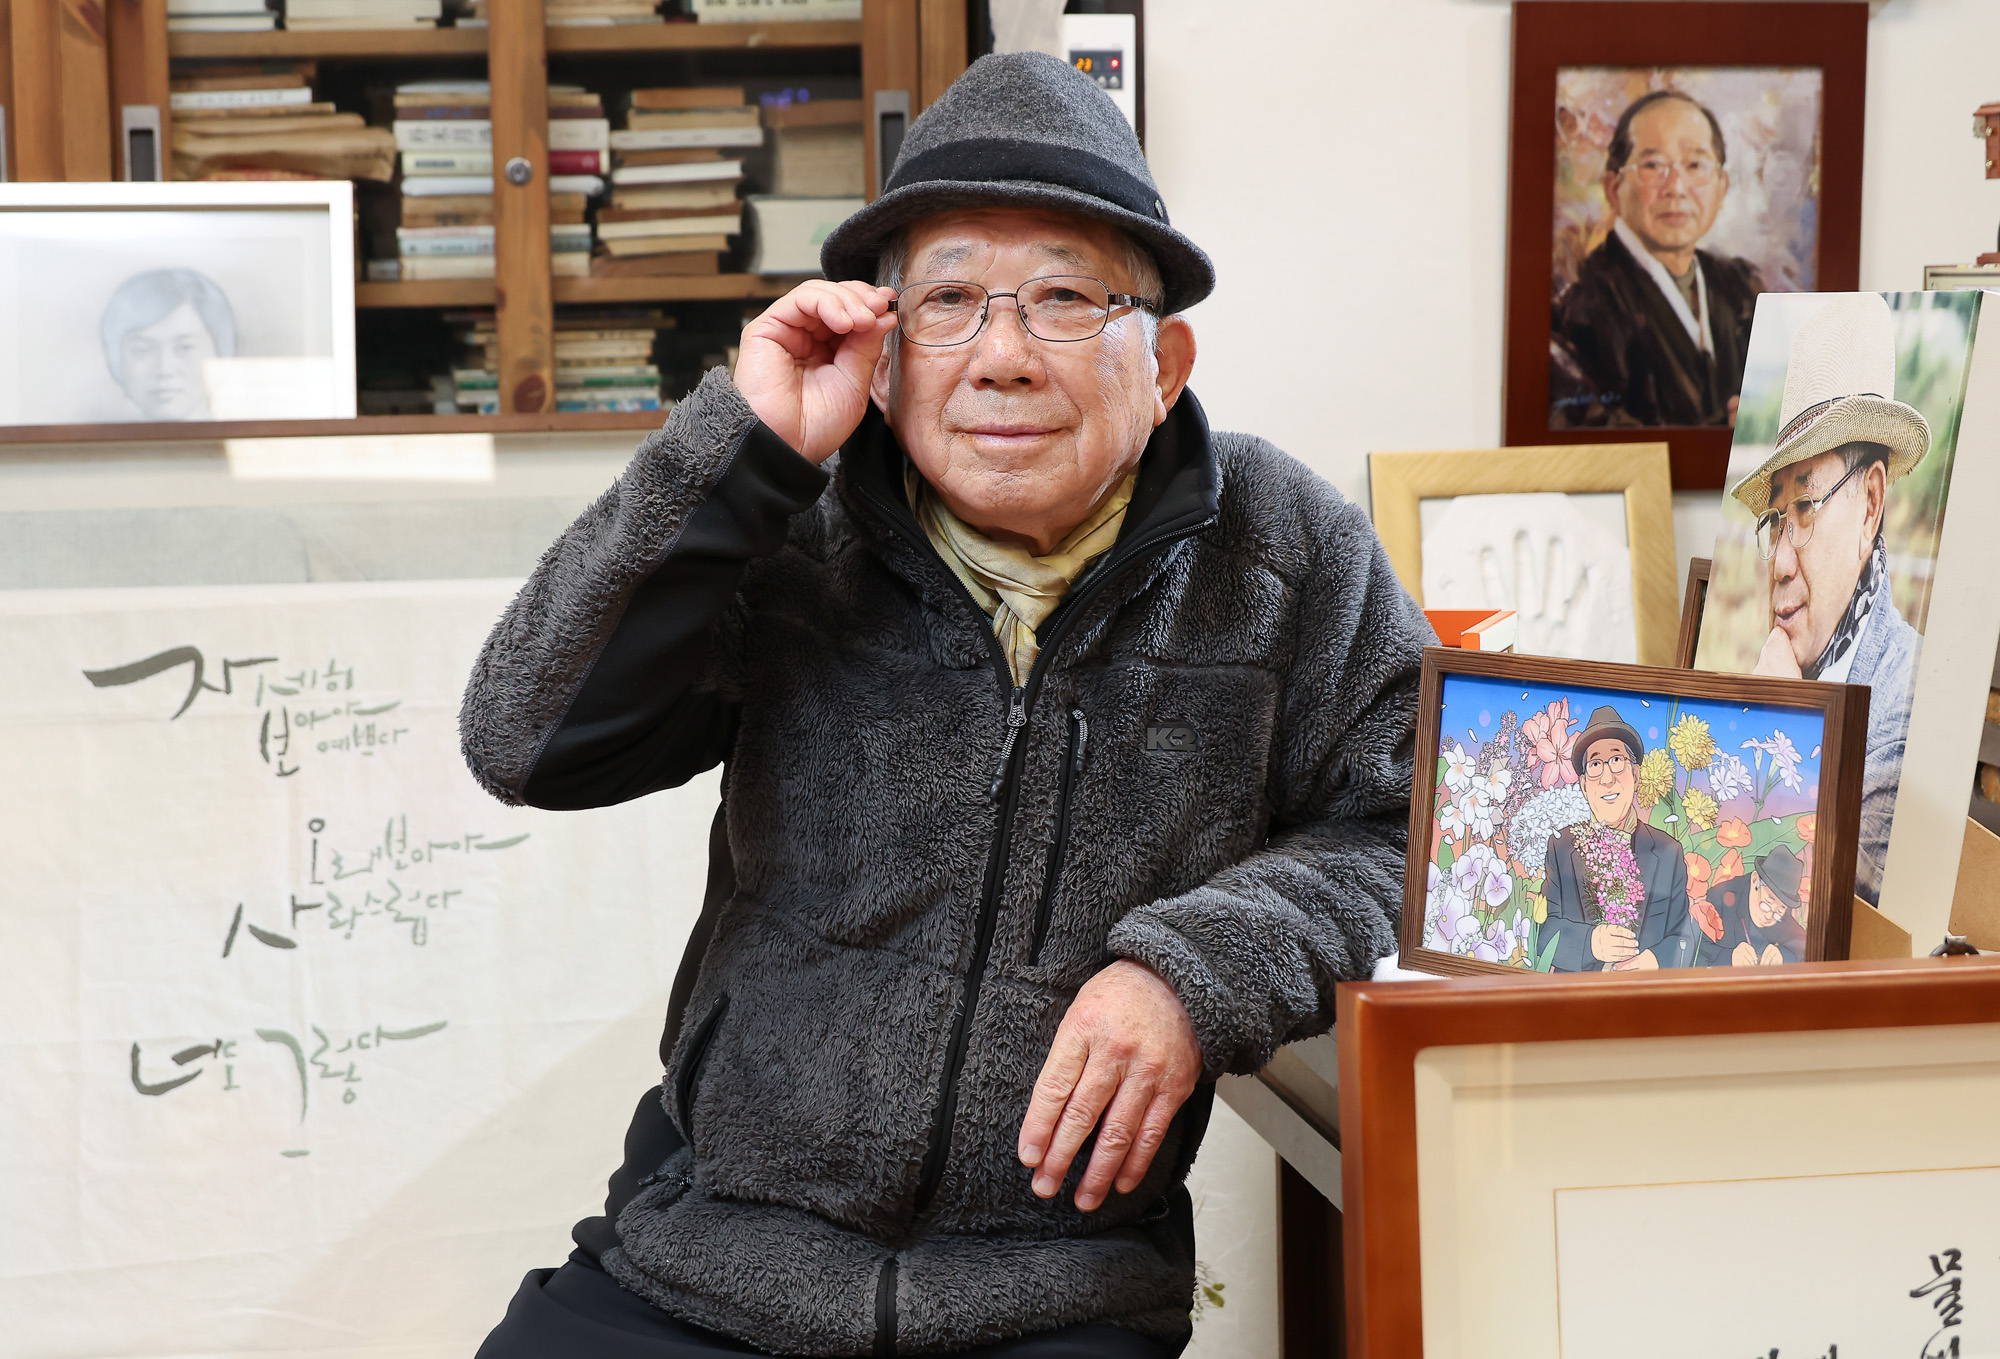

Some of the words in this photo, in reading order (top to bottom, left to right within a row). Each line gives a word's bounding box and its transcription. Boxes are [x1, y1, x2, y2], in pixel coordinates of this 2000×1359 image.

[82, 645, 353, 720] 자세히
[260, 700, 401, 776] 보아야
[316, 722, 408, 756] 예쁘다
[1146, 727, 1197, 752] K2
[308, 818, 382, 884] 오래
[385, 813, 531, 870] 보아야
[222, 878, 463, 958] 사랑스럽다
[131, 1038, 240, 1095] 너도
[254, 1020, 448, 1157] 그렇다
